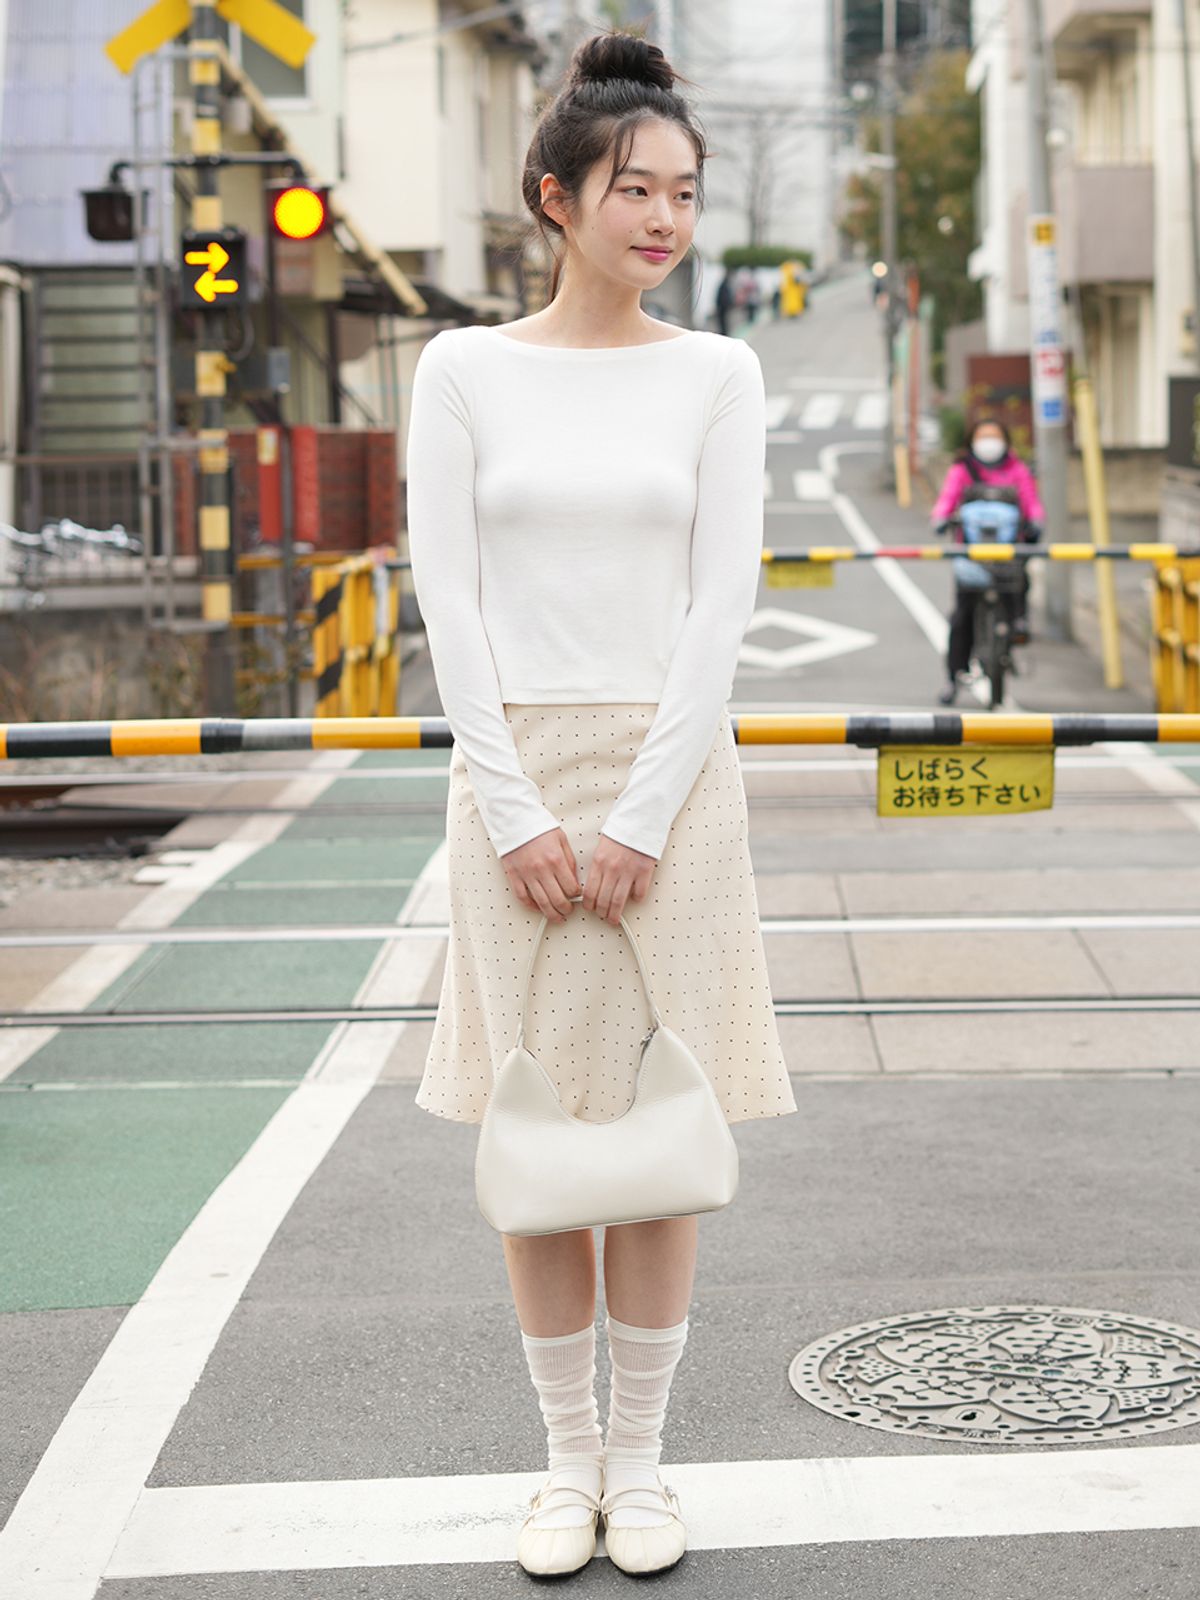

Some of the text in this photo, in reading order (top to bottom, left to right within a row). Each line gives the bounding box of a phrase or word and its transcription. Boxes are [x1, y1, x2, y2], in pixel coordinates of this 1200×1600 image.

[895, 757, 988, 781] しばらく
[893, 784, 1041, 808] お待ち下さい
